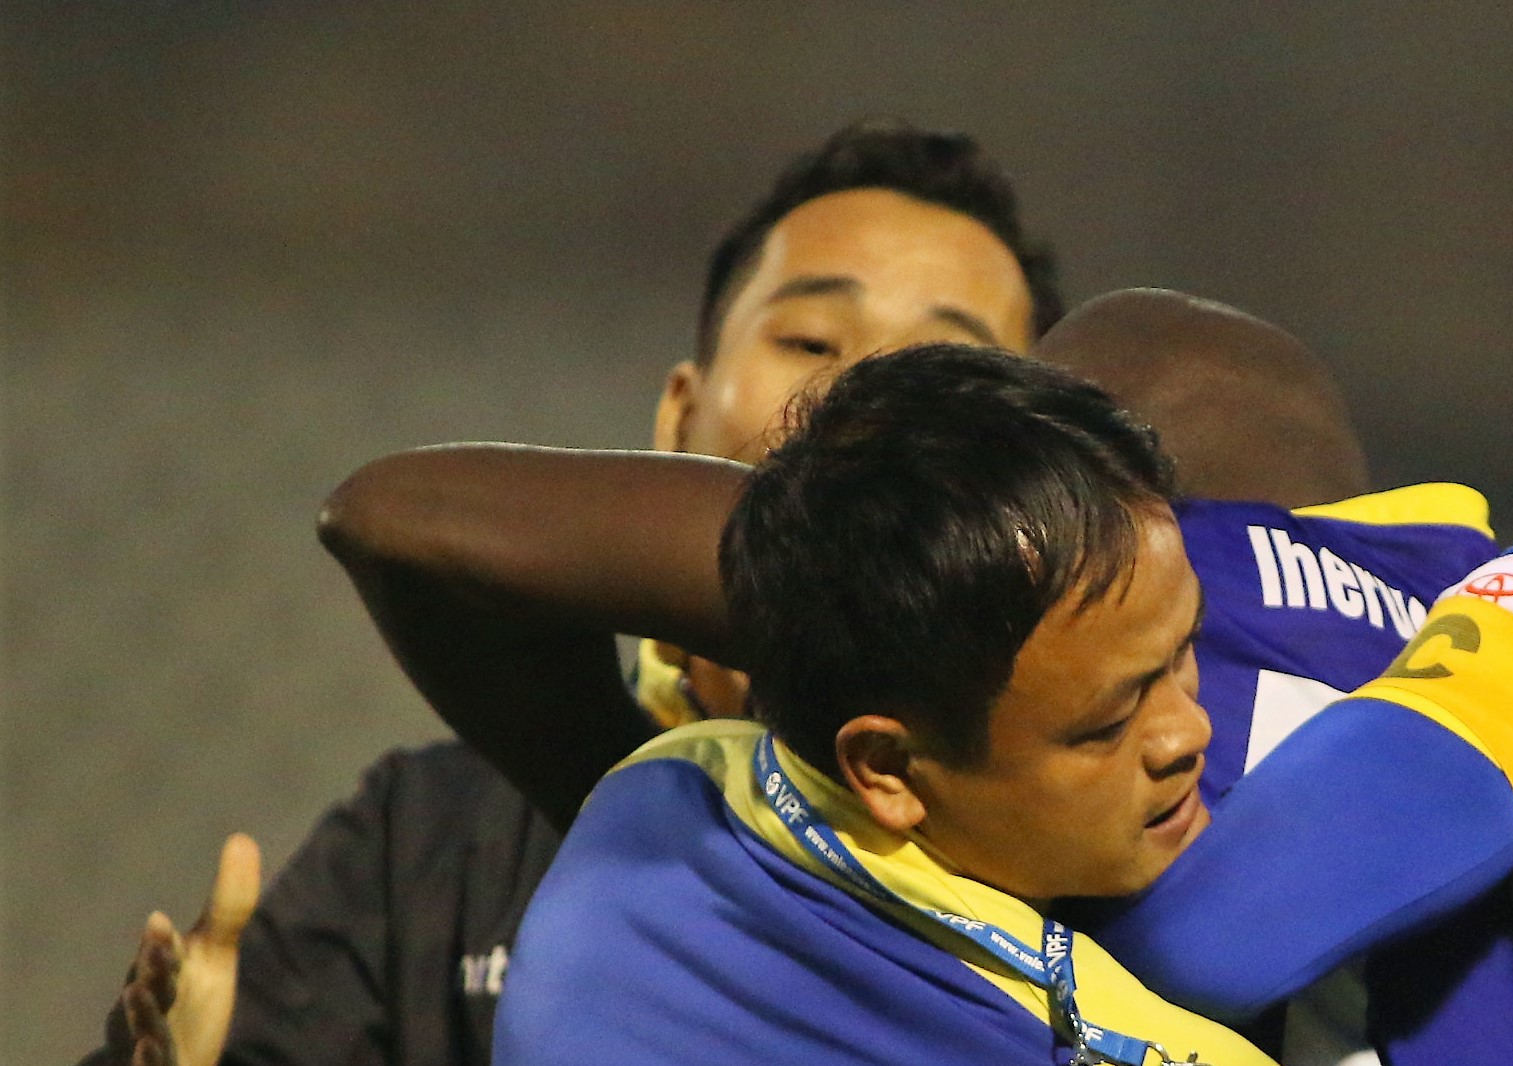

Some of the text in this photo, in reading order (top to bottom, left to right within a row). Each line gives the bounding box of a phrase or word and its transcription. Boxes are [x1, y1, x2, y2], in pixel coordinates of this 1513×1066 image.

[1381, 613, 1481, 678] C
[774, 784, 809, 823] VPF
[934, 910, 987, 932] VPF
[1046, 933, 1069, 968] VPF
